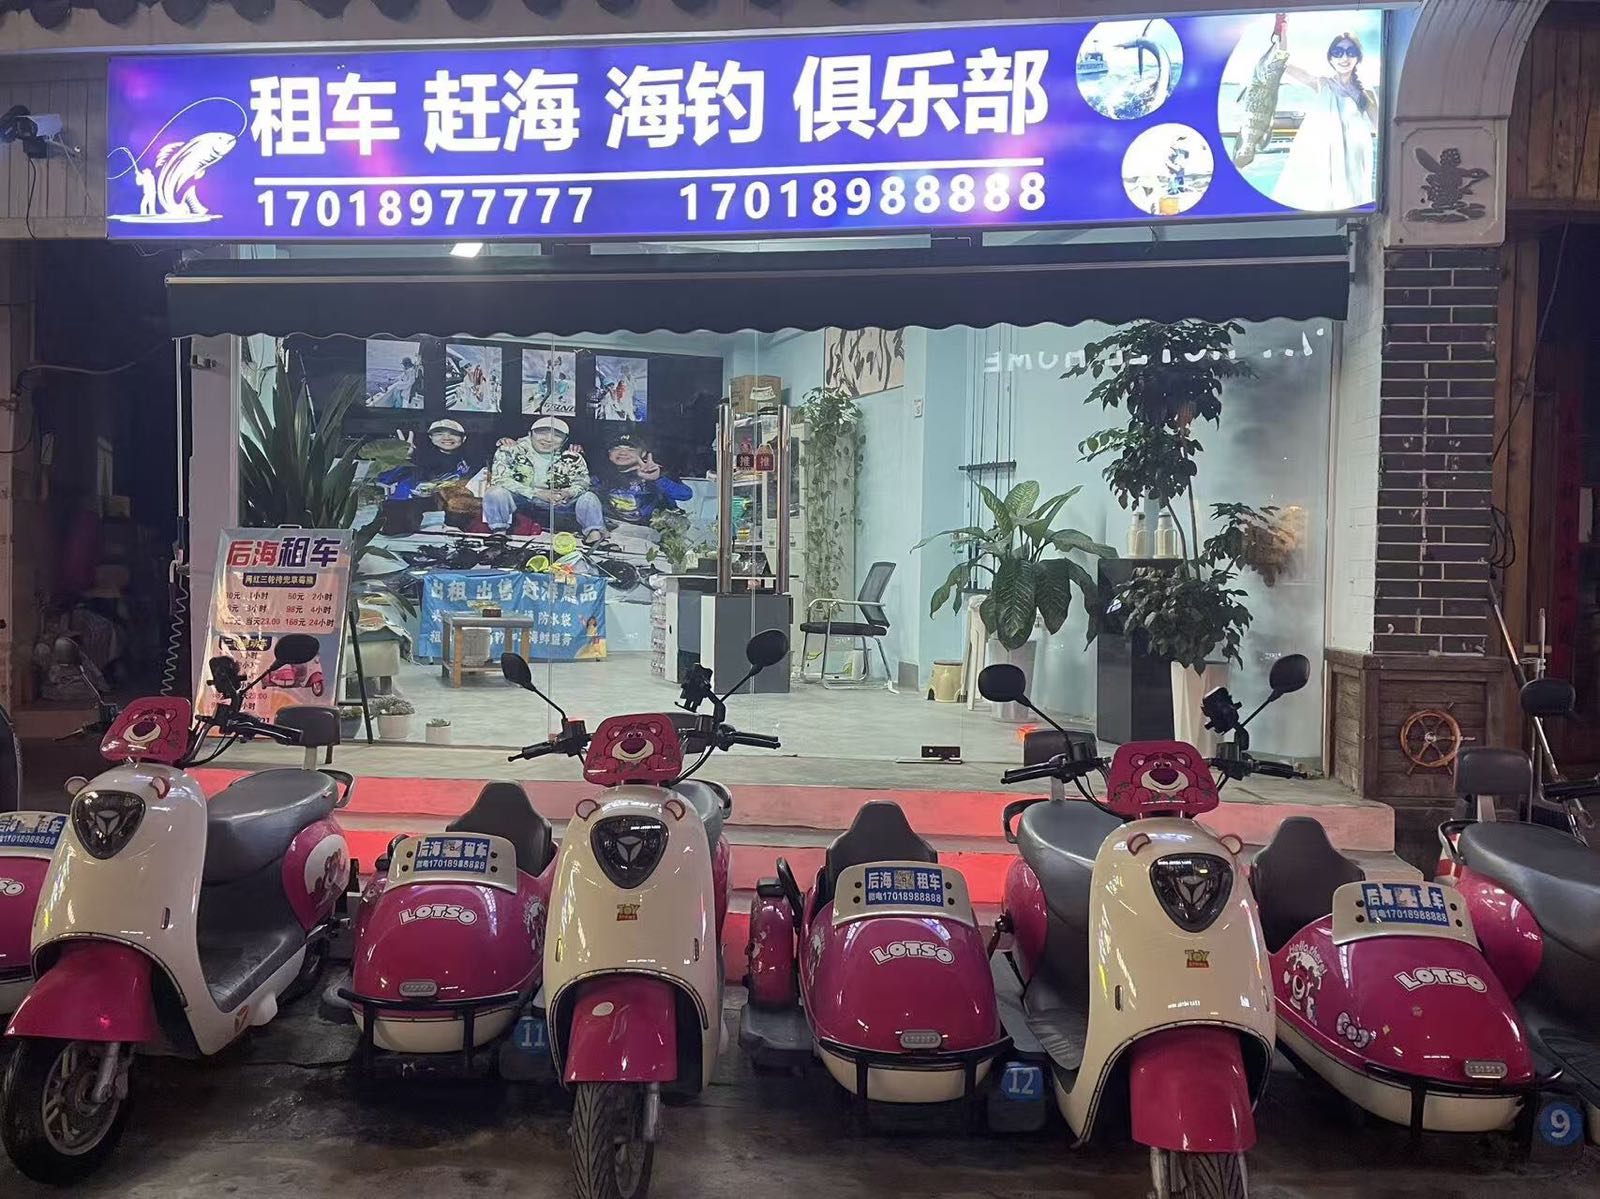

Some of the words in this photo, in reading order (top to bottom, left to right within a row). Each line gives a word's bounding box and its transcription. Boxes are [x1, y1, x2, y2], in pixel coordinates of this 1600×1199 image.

[249, 72, 401, 158] 租车
[422, 68, 581, 155] 赶海
[604, 59, 765, 150] 海钓
[793, 46, 1050, 143] 俱乐部
[256, 186, 594, 228] 17018977777
[679, 171, 1047, 221] 17018988888
[226, 537, 342, 568] 后海租车
[417, 841, 442, 858] 后海
[463, 841, 488, 859] 租车
[867, 871, 892, 890] 后海
[916, 872, 942, 891] 租车
[399, 903, 478, 926] LOTSO
[869, 940, 955, 966] LOTSO
[1393, 967, 1488, 993] LOTSO
[521, 1022, 546, 1047] 11
[1007, 1070, 1035, 1095] 12
[1550, 1109, 1571, 1138] 9
